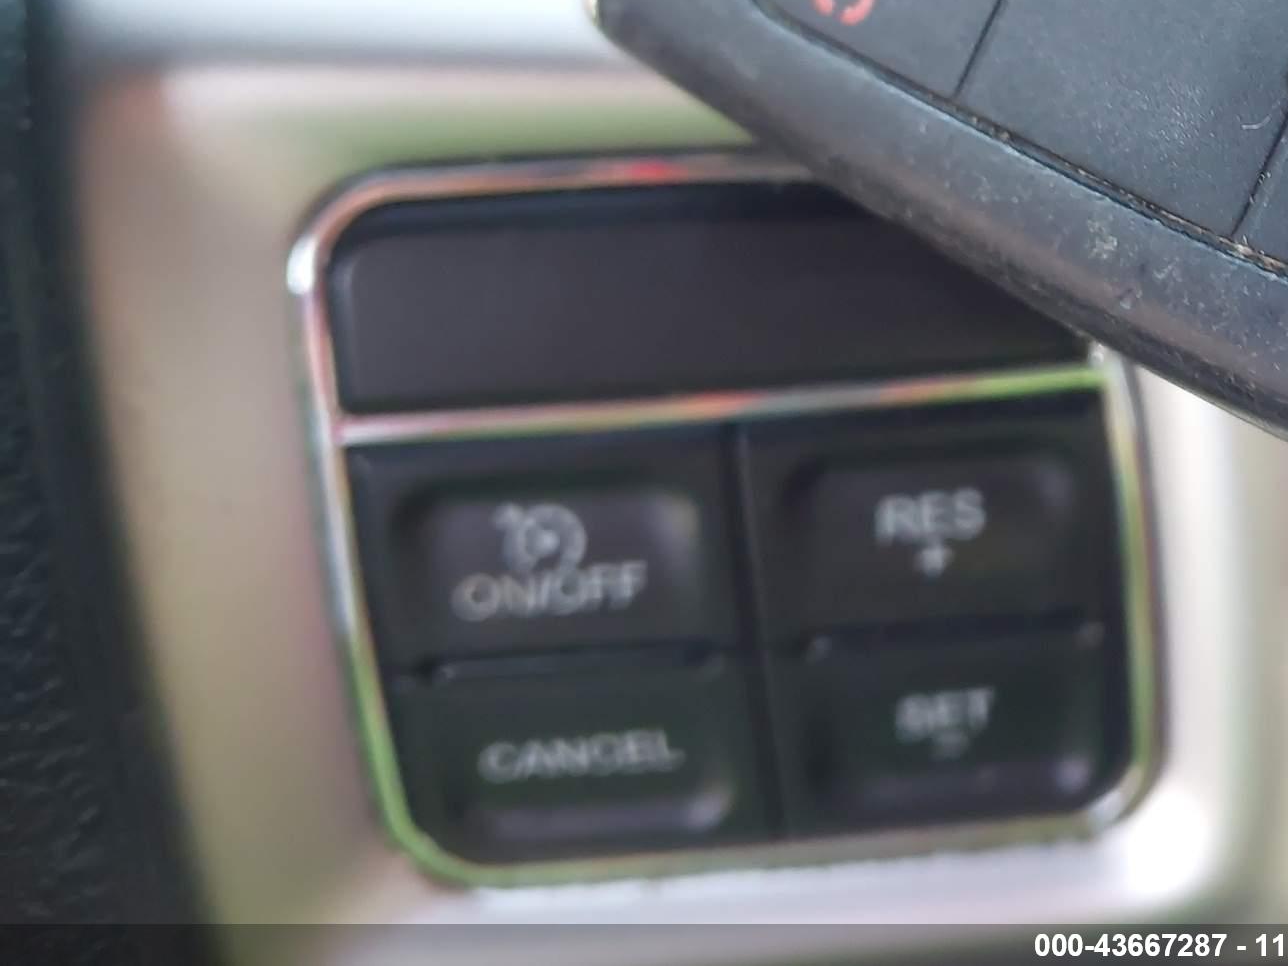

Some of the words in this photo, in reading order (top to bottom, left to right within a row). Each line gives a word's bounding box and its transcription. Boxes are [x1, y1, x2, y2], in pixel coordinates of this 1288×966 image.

[877, 489, 986, 543] RES
[453, 562, 646, 621] ON/OFF
[897, 688, 994, 740] SET
[479, 731, 682, 781] CANCEL
